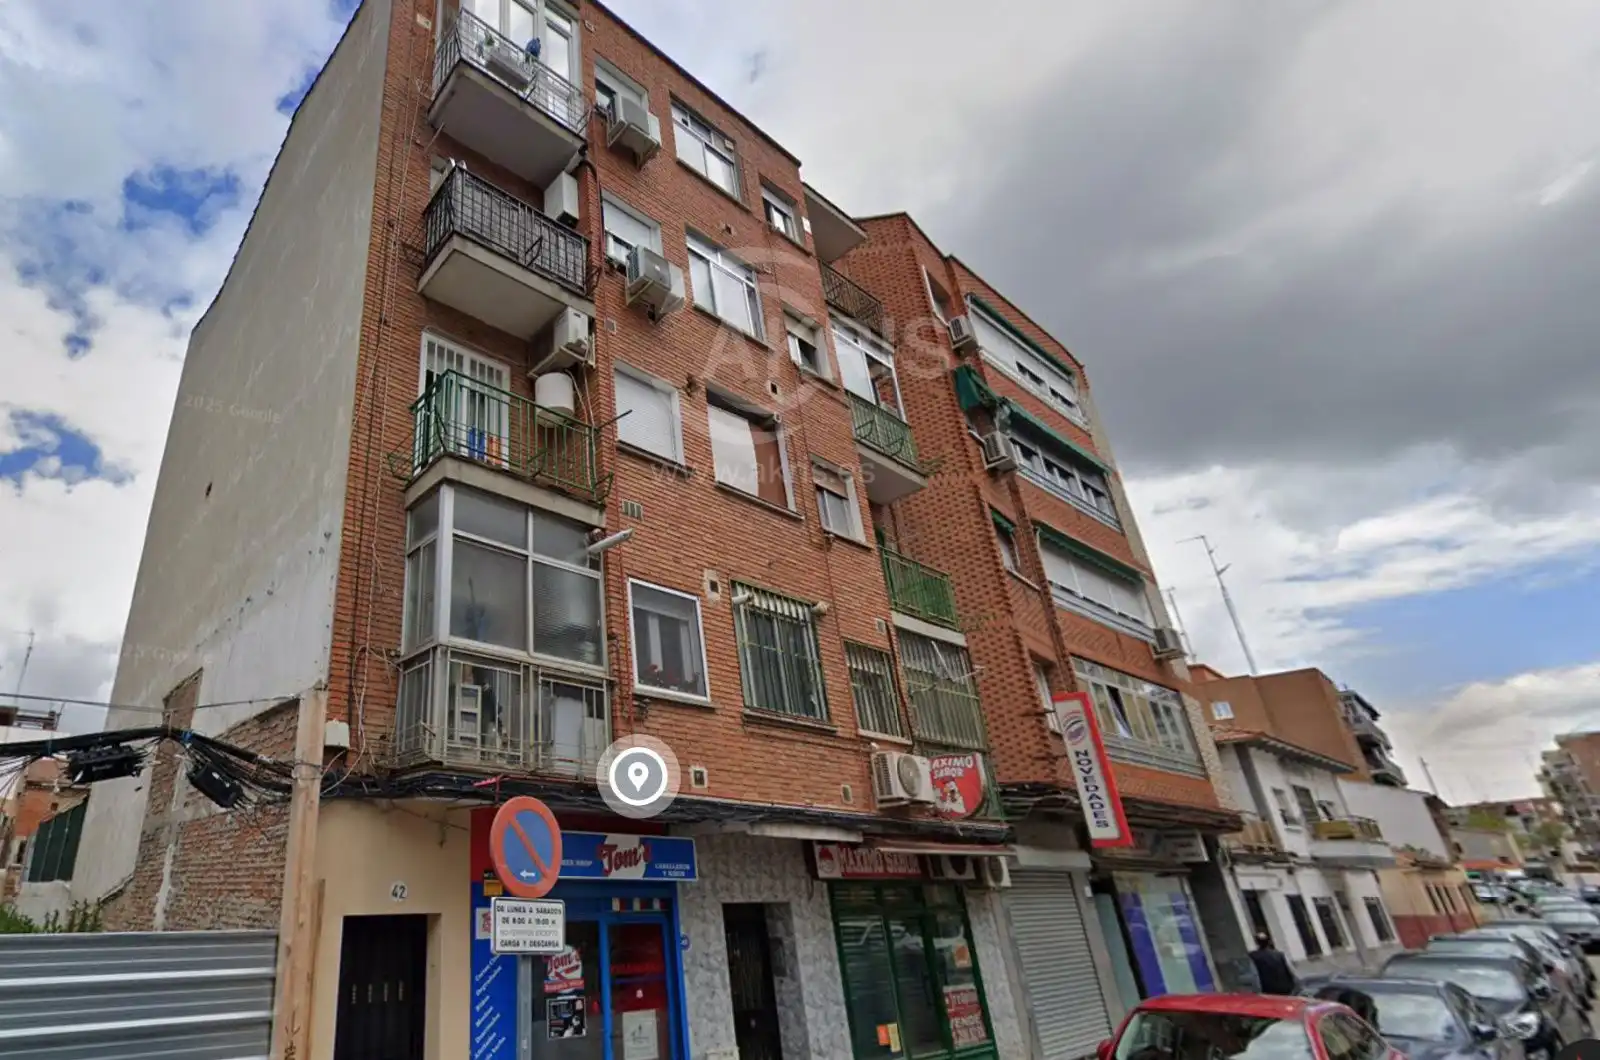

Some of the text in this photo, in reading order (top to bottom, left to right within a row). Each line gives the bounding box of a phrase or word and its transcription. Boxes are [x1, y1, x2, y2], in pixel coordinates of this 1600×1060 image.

[931, 756, 973, 769] AXIMO
[1074, 750, 1109, 828] NOVEDADES
[597, 843, 652, 876] Tom's
[391, 884, 406, 898] 42
[507, 905, 526, 913] LUNES
[502, 916, 509, 924] DE
[500, 940, 520, 948] CARGA
[529, 940, 559, 948] DESCARGA
